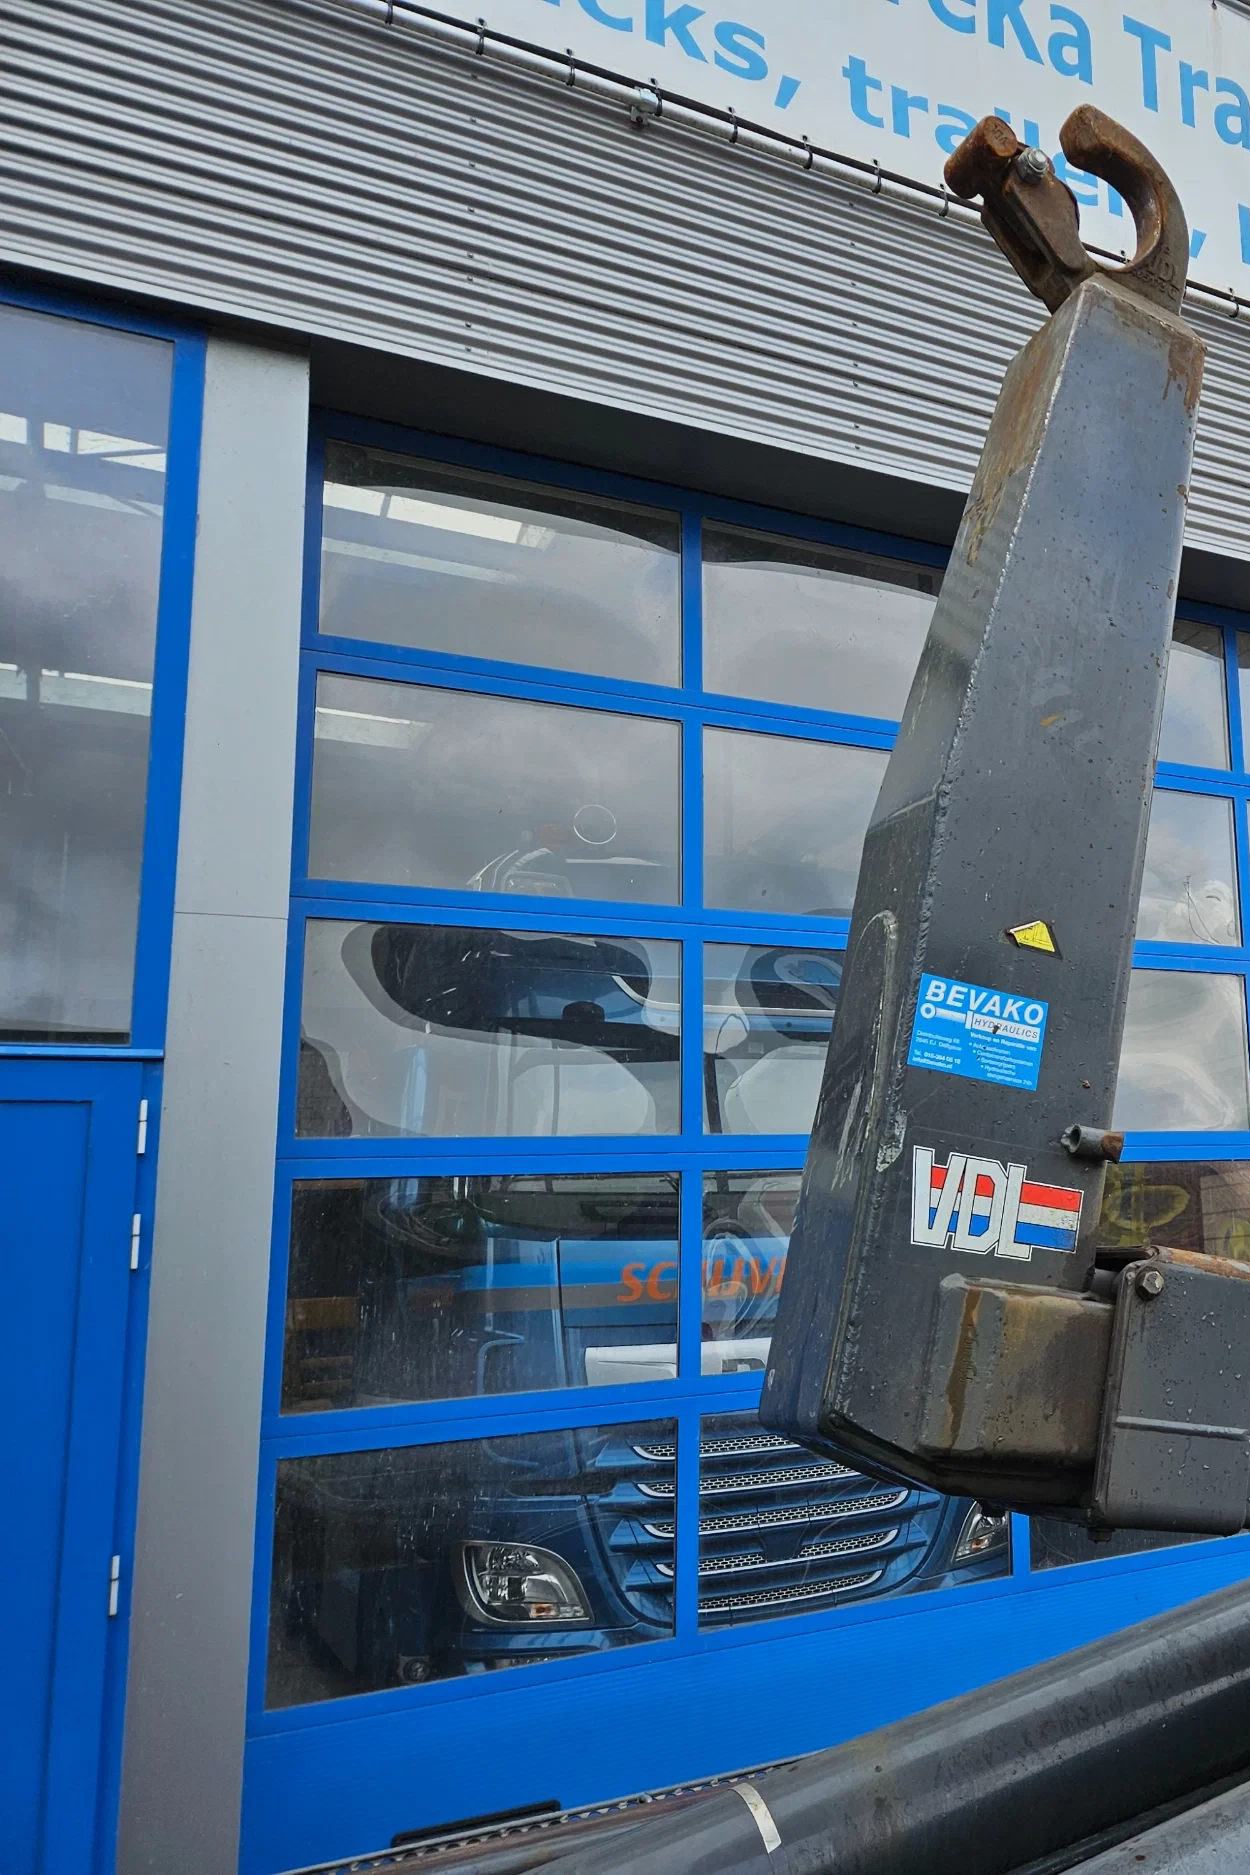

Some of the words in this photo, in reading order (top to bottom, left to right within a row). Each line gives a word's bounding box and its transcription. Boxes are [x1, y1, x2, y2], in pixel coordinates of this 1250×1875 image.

[924, 979, 1044, 1026] BEVAKO
[973, 1017, 1039, 1040] HYDRAULICS
[911, 1145, 1032, 1262] VDL
